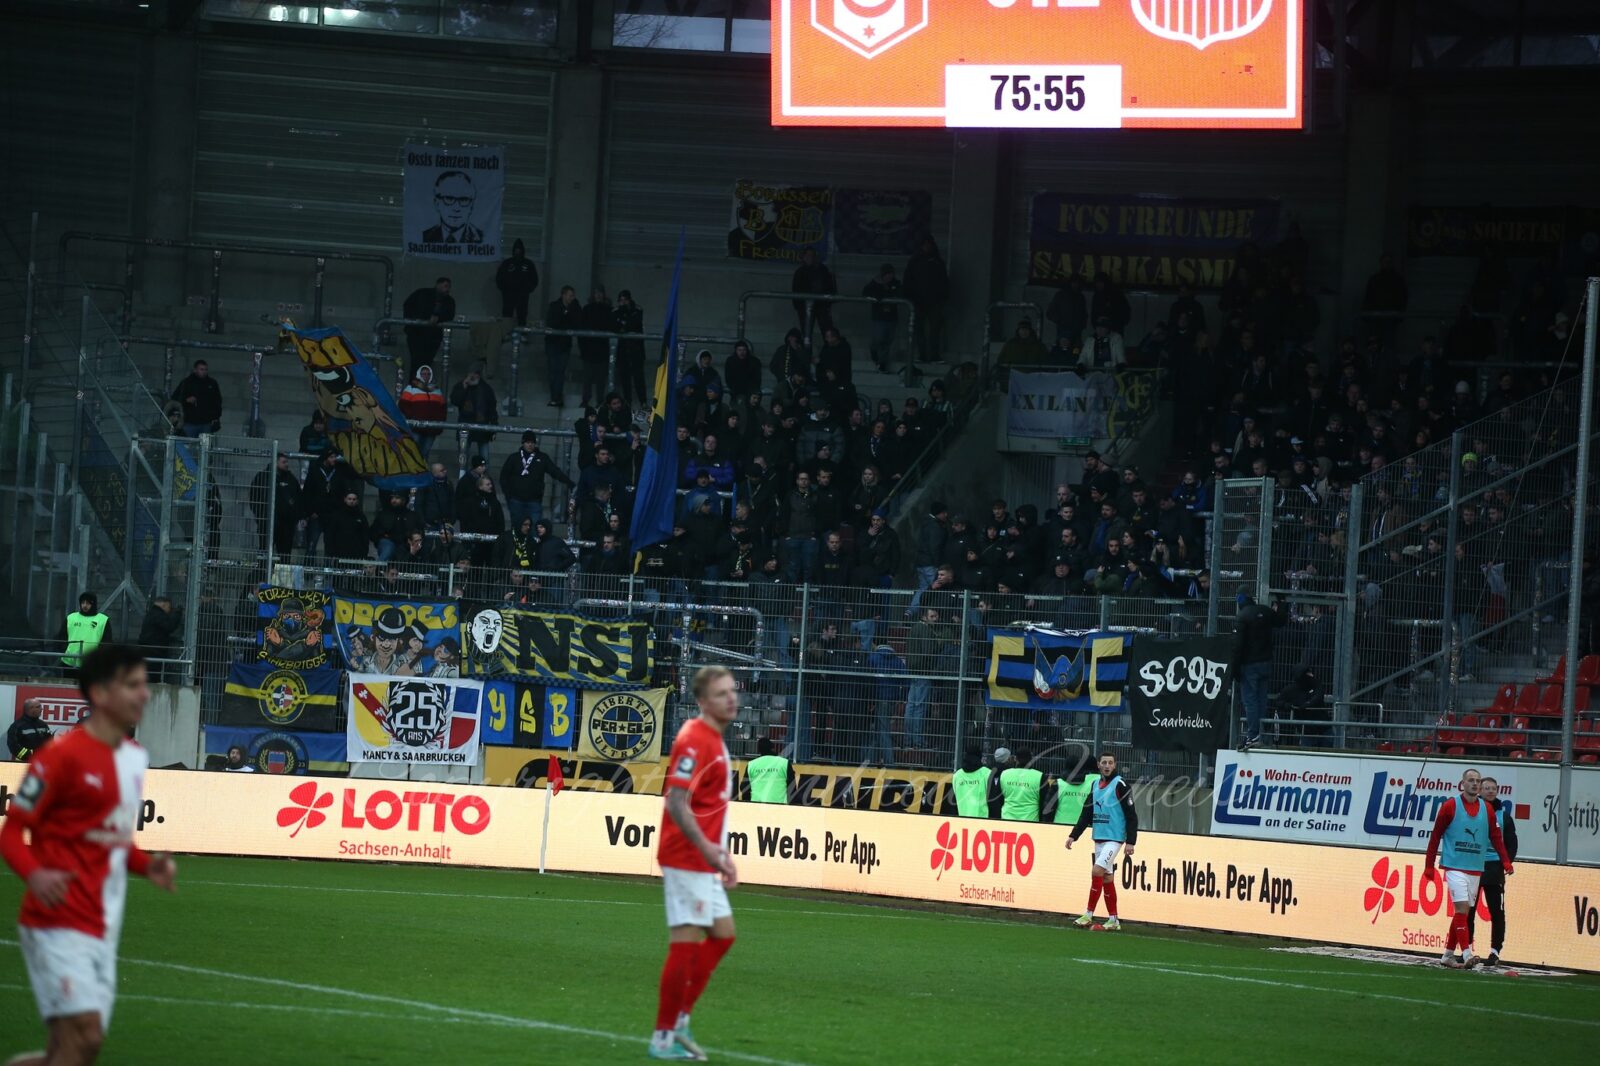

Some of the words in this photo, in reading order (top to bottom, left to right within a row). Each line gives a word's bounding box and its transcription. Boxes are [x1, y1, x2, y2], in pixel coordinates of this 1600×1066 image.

[990, 75, 1085, 111] 75:55
[1057, 203, 1109, 233] FCS
[1117, 205, 1255, 240] FREUNDE
[1138, 656, 1228, 700] SC95
[395, 691, 437, 729] 25
[363, 750, 393, 760] NANCY
[1214, 763, 1352, 826] Lührmann
[1264, 768, 1352, 786] Wohn-Centrum
[340, 787, 491, 836] LOTTO
[1265, 818, 1280, 827] an
[1283, 817, 1304, 829] der
[1306, 818, 1346, 832] Saline
[338, 839, 452, 860] Sachsen-Anhalt
[605, 815, 656, 848] Vor
[757, 826, 817, 862] Web.
[825, 831, 848, 863] Per
[850, 833, 880, 875] App.
[960, 828, 1035, 877] LOTTO
[960, 883, 1015, 903] Sachsen-Anhalt
[1121, 855, 1151, 892] Ort.
[1156, 859, 1177, 894] Im
[1182, 861, 1221, 899] Web.
[1226, 863, 1255, 902] Per
[1259, 867, 1298, 915] App.
[1574, 895, 1600, 936] Vo
